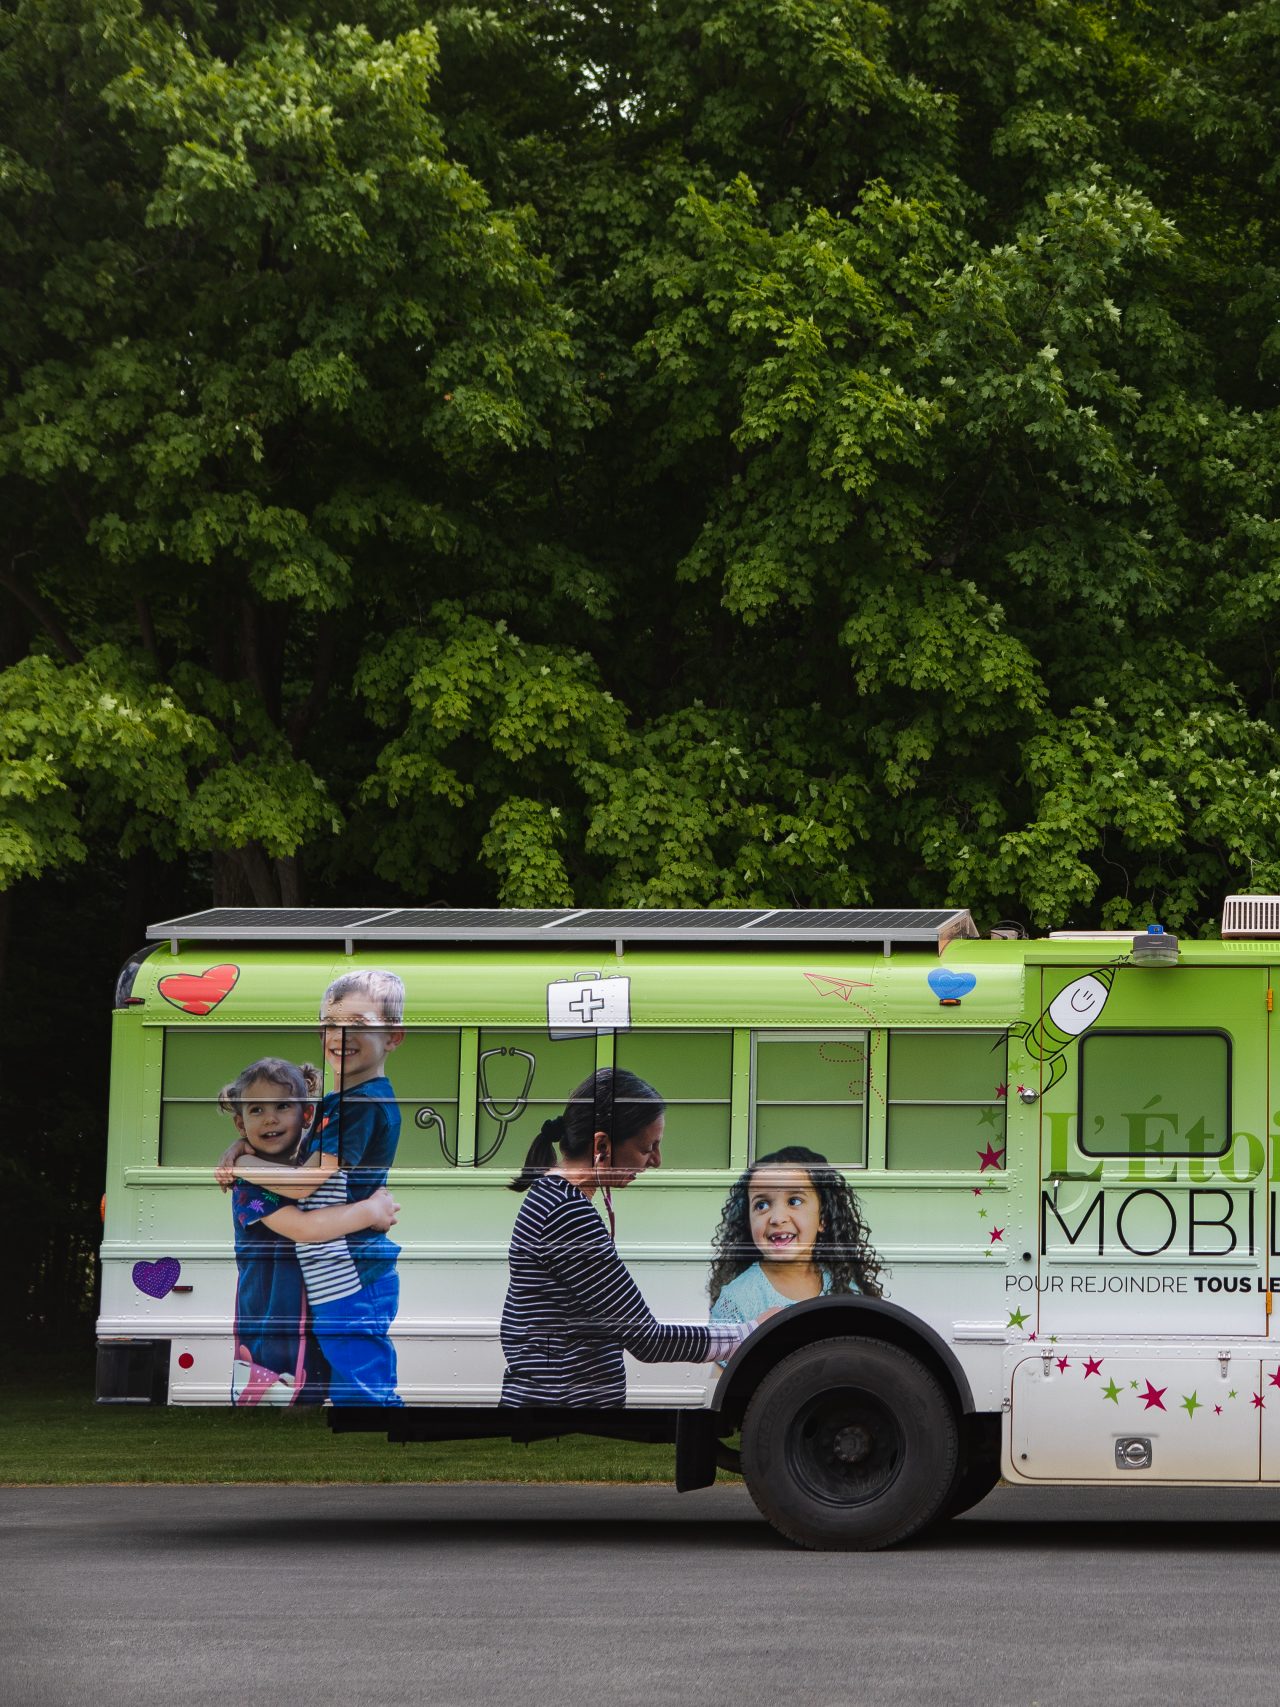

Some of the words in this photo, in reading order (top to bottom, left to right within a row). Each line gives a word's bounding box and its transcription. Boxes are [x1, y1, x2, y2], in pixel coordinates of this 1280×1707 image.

[1005, 1274, 1064, 1293] POUR
[1070, 1275, 1188, 1293] REJOINDRE
[1194, 1276, 1252, 1293] TOUS
